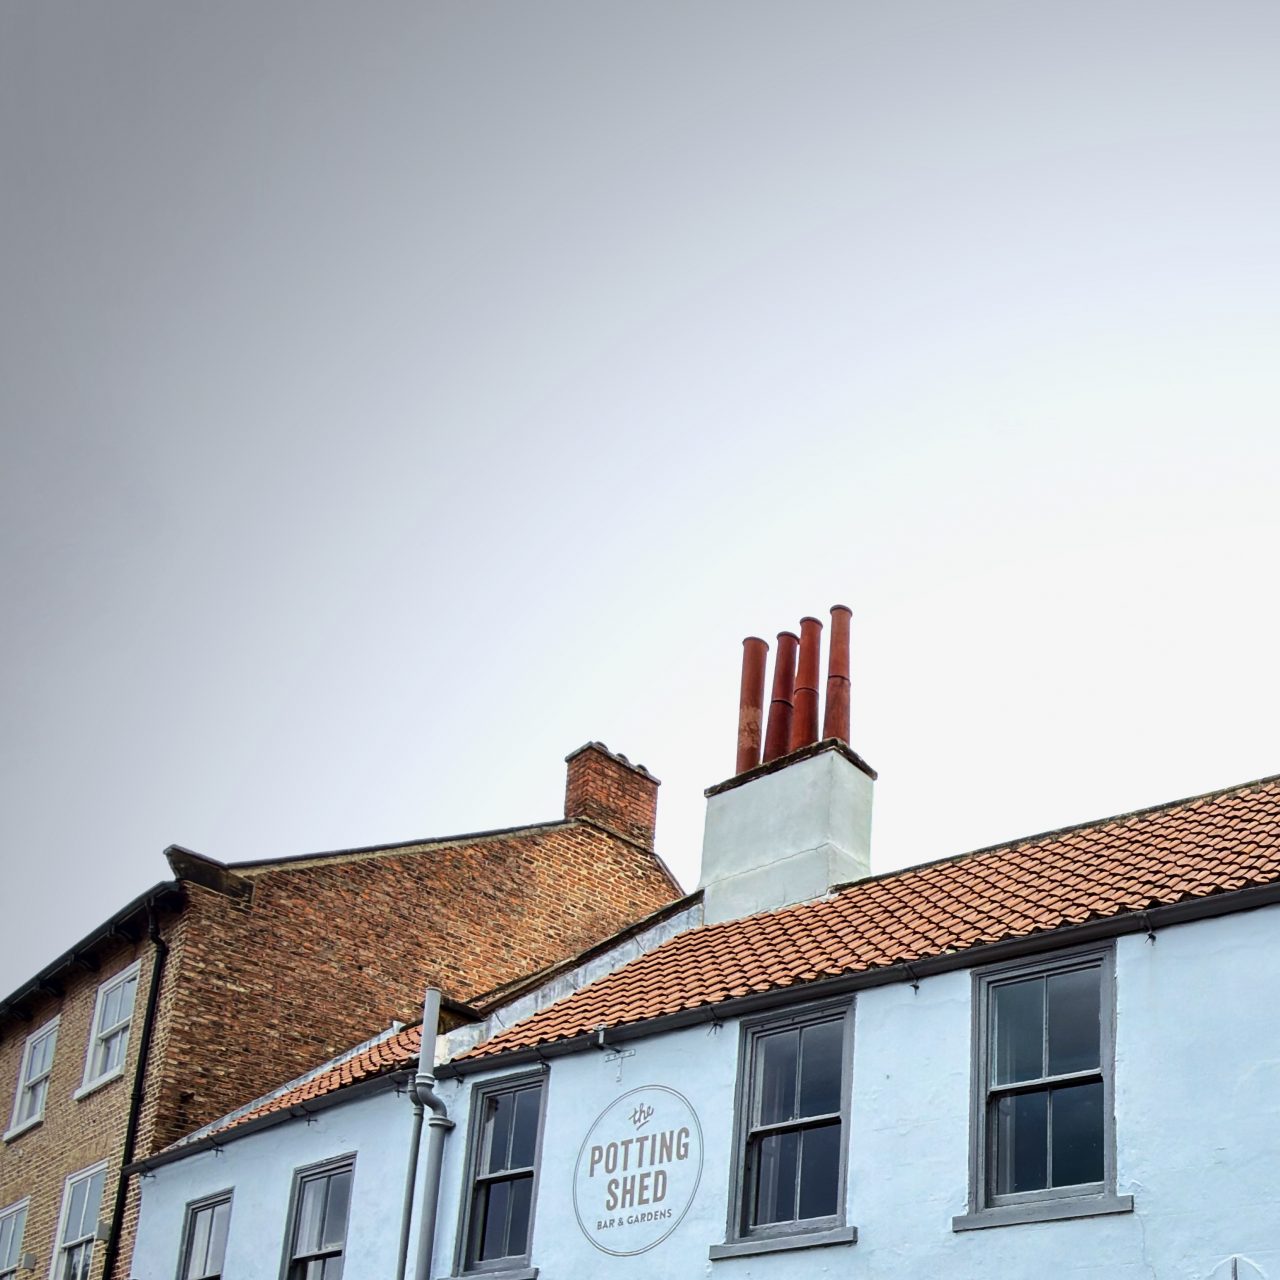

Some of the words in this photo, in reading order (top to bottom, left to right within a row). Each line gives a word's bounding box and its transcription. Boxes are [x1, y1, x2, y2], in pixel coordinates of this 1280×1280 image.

[628, 1102, 654, 1127] the
[589, 1126, 690, 1178] POTTING
[606, 1169, 668, 1212] SHED
[597, 1218, 616, 1231] BAR
[617, 1217, 624, 1227] &
[627, 1208, 672, 1226] GARDENS
